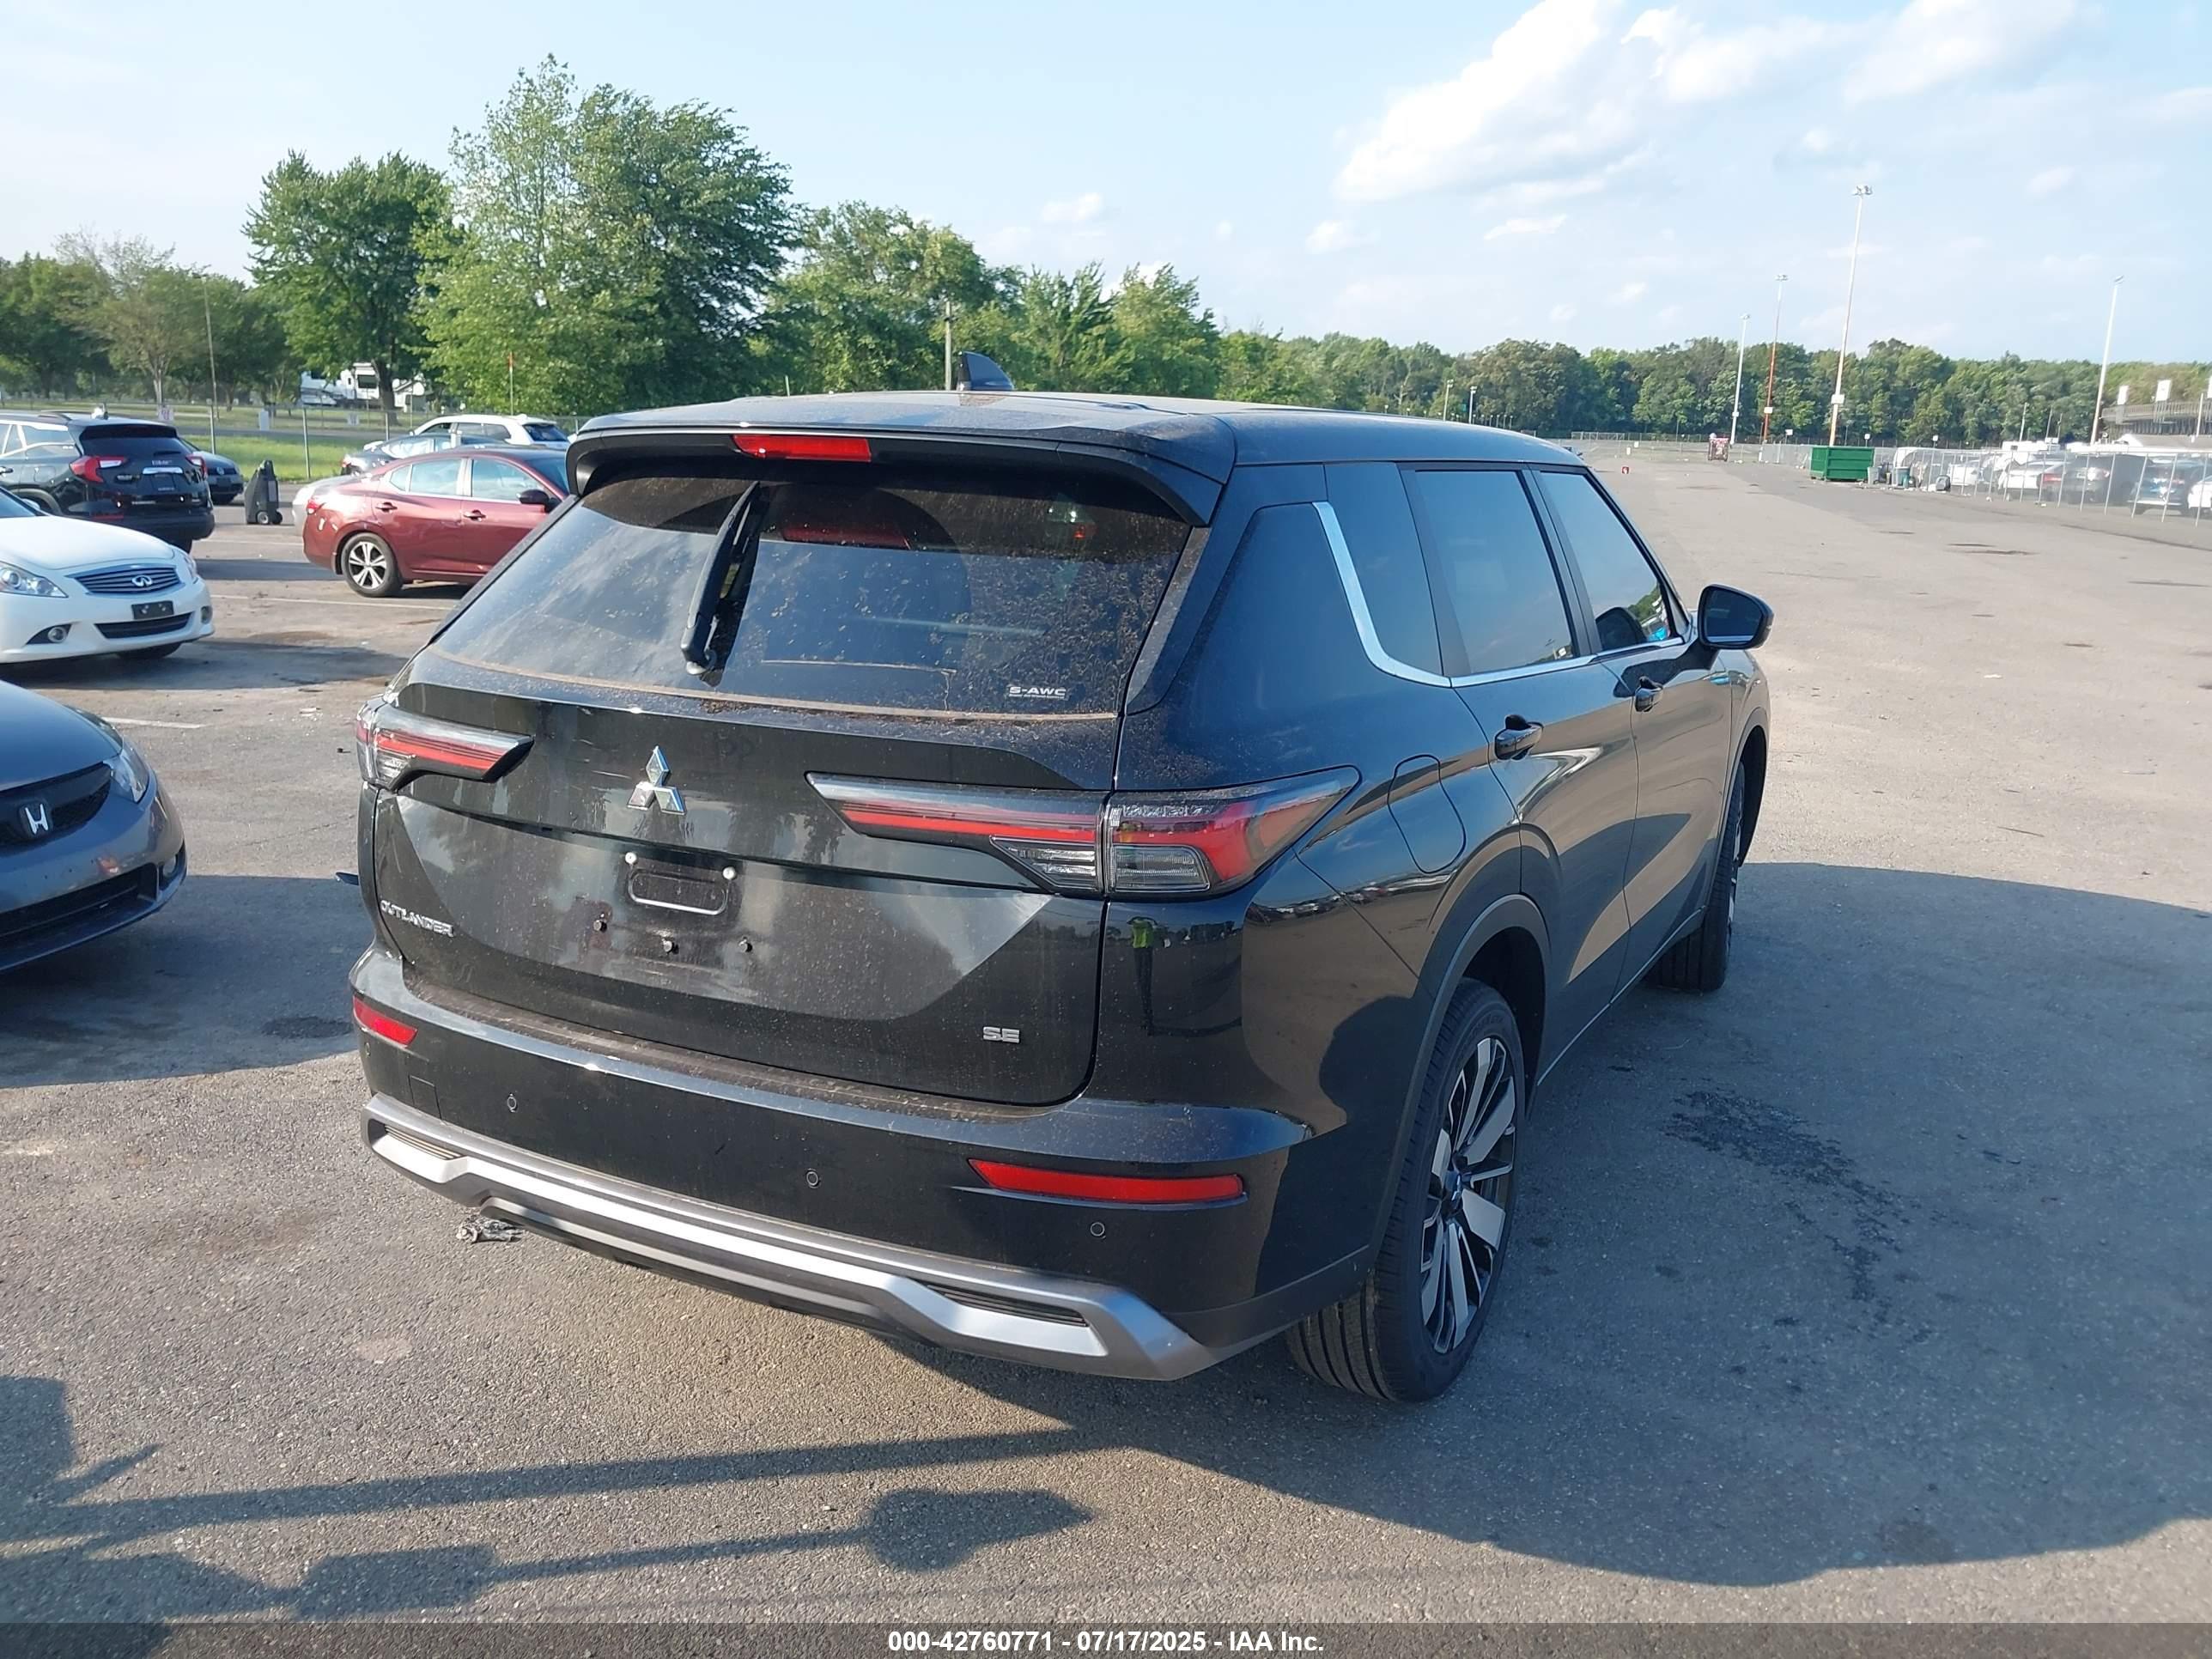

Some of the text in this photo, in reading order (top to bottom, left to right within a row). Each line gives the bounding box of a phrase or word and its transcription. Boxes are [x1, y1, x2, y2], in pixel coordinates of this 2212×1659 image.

[1009, 686, 1066, 696] S-AWC
[380, 899, 454, 938] OUTLANDER
[982, 1026, 1020, 1043] SE
